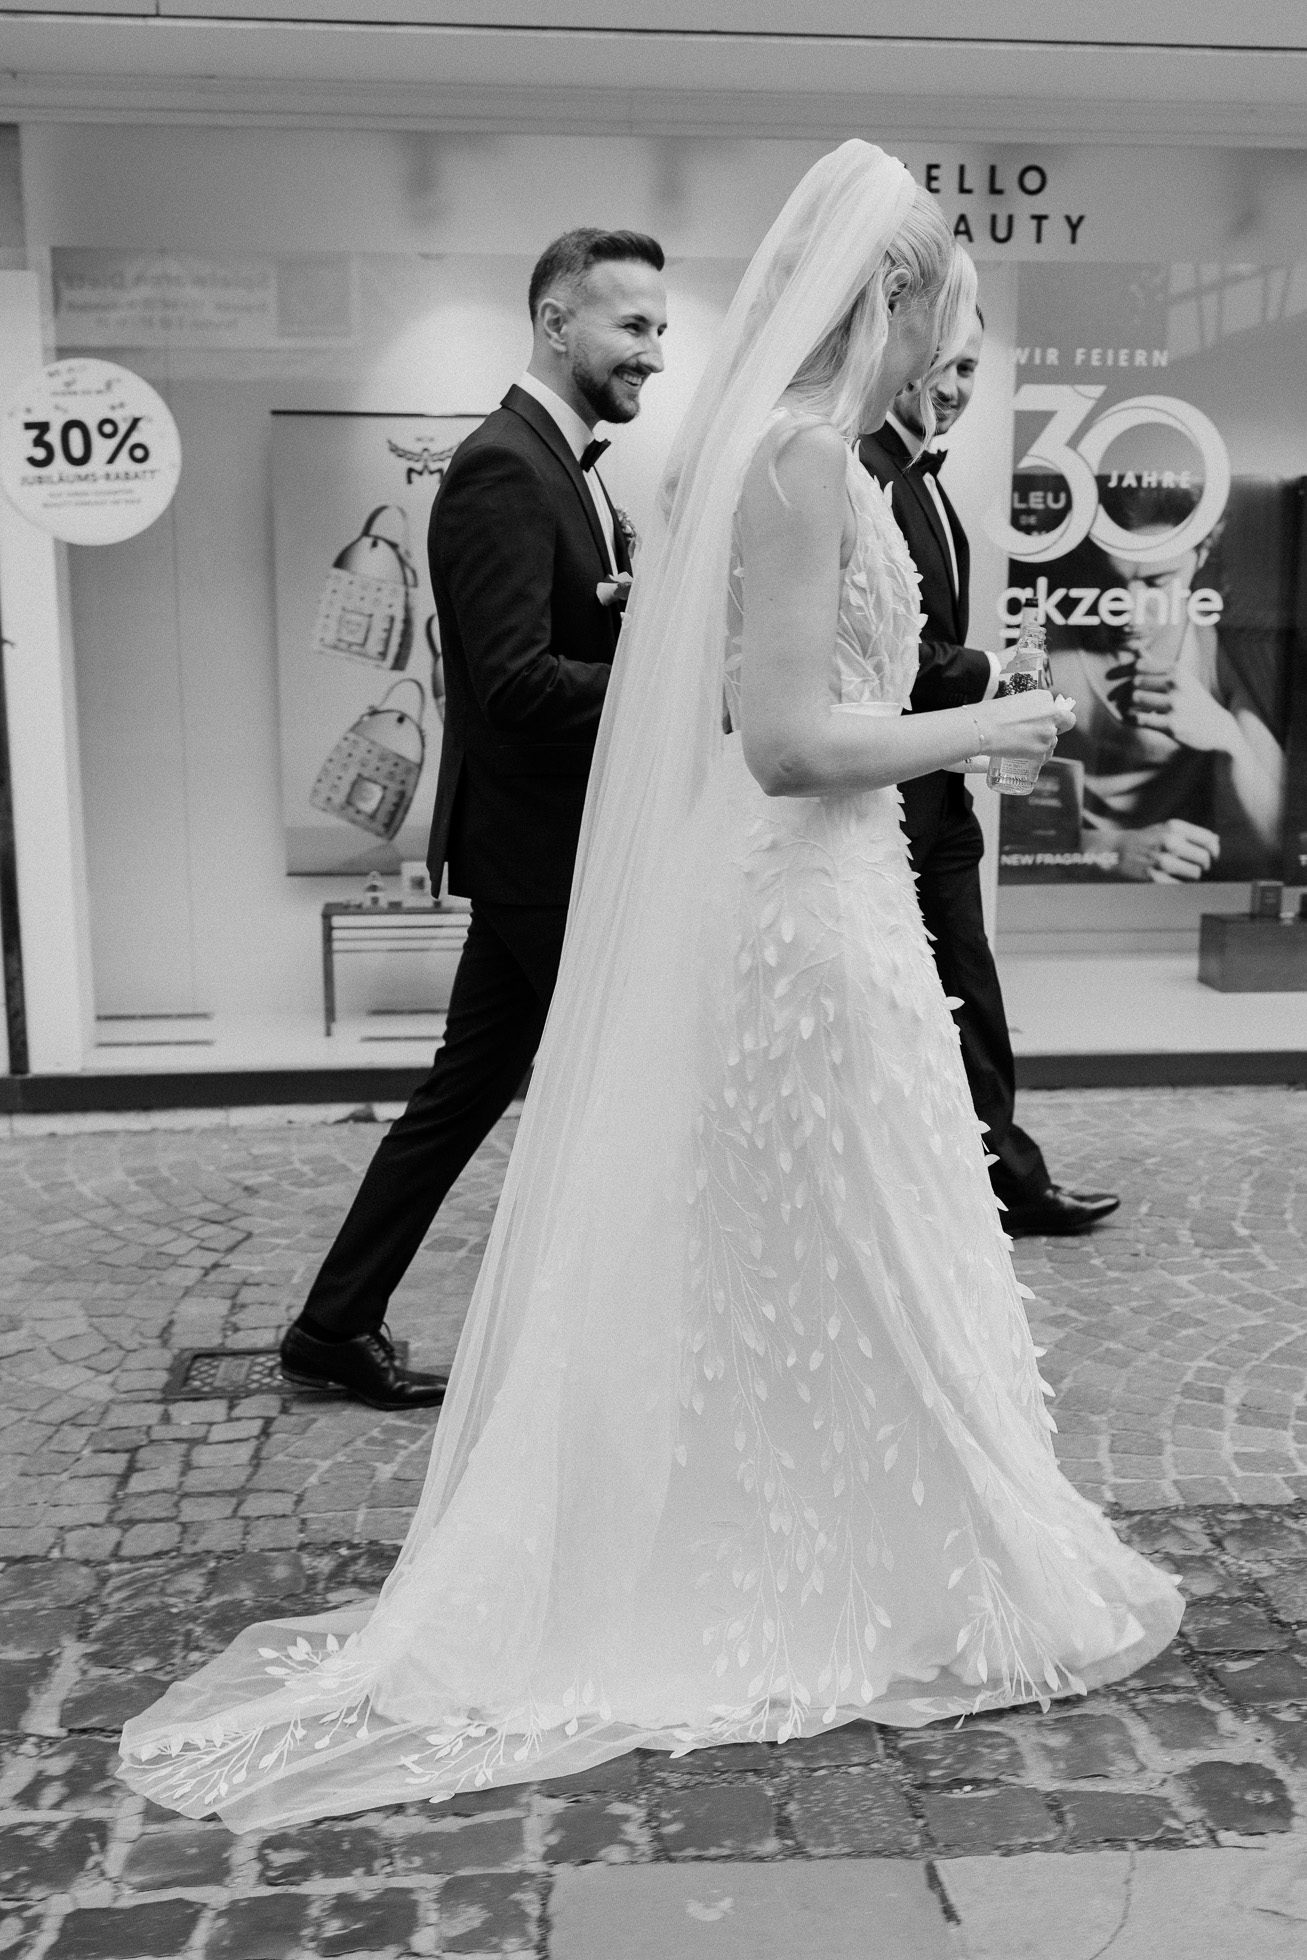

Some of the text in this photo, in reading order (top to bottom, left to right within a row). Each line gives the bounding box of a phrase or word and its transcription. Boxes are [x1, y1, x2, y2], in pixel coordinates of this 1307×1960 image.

[903, 163, 1048, 196] ELLO
[953, 213, 1086, 244] AUTY
[1012, 347, 1169, 367] WIR FEIERN
[23, 417, 150, 468] 30%
[981, 384, 1231, 563] 30
[1107, 469, 1192, 489] JAHRE
[1013, 490, 1067, 510] LEU
[997, 576, 1225, 628] akzente
[1001, 853, 1034, 866] NEW
